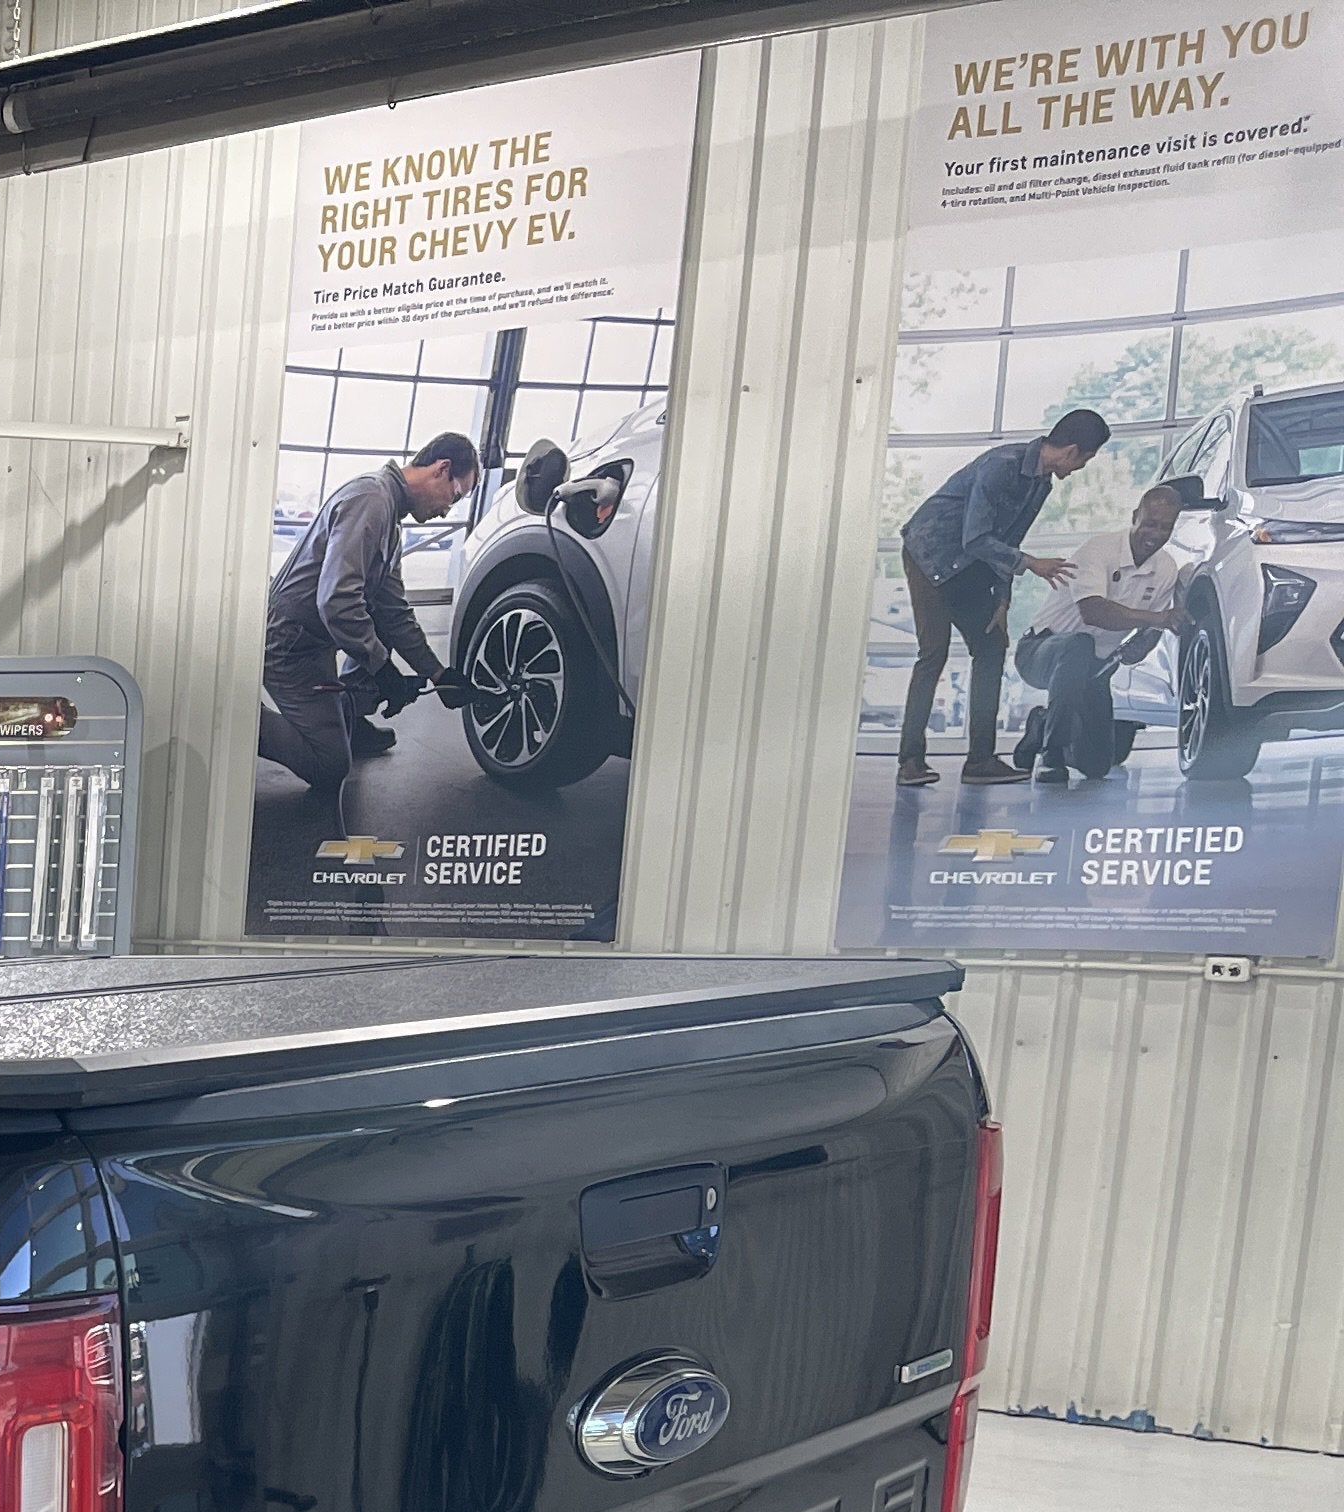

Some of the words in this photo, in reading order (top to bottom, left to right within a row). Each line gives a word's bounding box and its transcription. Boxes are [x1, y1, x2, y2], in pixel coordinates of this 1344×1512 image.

[954, 48, 1081, 96] WE'RE
[1095, 29, 1207, 78] WITH
[1221, 11, 1310, 59] YOU
[948, 101, 1022, 140] ALL
[1036, 88, 1116, 130] THE
[1130, 72, 1230, 118] WAY.
[324, 161, 372, 195] WE
[382, 143, 479, 188] KNOW
[489, 130, 552, 170] THE
[941, 186, 982, 196] Includes:
[984, 184, 995, 193] oil
[998, 182, 1014, 191] and
[1016, 181, 1027, 190] oil
[1029, 178, 1053, 189] filter
[1054, 176, 1091, 188] change,
[1093, 171, 1121, 182] diesel
[1123, 167, 1160, 179] exhaust
[1163, 163, 1185, 174] fluid
[1188, 160, 1209, 170] tank
[1211, 155, 1235, 167] refill
[1258, 138, 1342, 161] diesel-equipped
[944, 161, 984, 177] Your
[989, 156, 1027, 174] first
[1032, 144, 1150, 170] maintenance
[1156, 133, 1197, 154] visit
[1202, 131, 1218, 148] is
[320, 193, 413, 235] RIGHT
[422, 179, 513, 221] TIRES
[524, 167, 588, 206] FOR
[1009, 193, 1026, 203] and
[1028, 189, 1079, 202] Multi-Point
[1082, 185, 1115, 196] Vehicle
[1118, 178, 1171, 192] Inspection.
[318, 236, 398, 273] YOUR
[408, 217, 518, 262] CHEVY
[527, 209, 576, 246] EV.
[312, 312, 338, 321] Provide
[339, 311, 348, 319] us
[350, 308, 365, 318] with
[373, 306, 395, 316] better
[397, 302, 423, 314] eligible
[425, 301, 444, 312] price
[446, 299, 454, 307] at
[455, 297, 467, 305] the
[470, 294, 486, 304] time
[488, 292, 496, 301] of
[498, 288, 535, 301] purchase,
[537, 285, 551, 295] and
[573, 278, 598, 289] match
[313, 289, 339, 304] Tire
[343, 285, 378, 301] Price
[383, 278, 424, 297] Match
[428, 271, 506, 291] Guarantee.
[311, 323, 326, 332] Find
[334, 320, 356, 330] better
[357, 319, 375, 330] price
[377, 316, 400, 326] within
[401, 314, 410, 323] 30
[412, 313, 429, 324] days
[431, 310, 439, 320] of
[441, 309, 452, 318] the
[454, 305, 491, 318] purchase,
[493, 302, 507, 312] and
[528, 296, 554, 307] refund
[555, 294, 568, 303] the
[0, 724, 44, 736] WIPERS
[426, 833, 546, 858] CERTIFIED
[1084, 826, 1244, 854] CERTIFIED
[312, 871, 407, 885] CHEVROLET
[424, 862, 523, 885] SERVICE
[929, 871, 1057, 885] CHEVROLET
[1081, 859, 1213, 886] SERVICE
[659, 1390, 715, 1446] Ford
